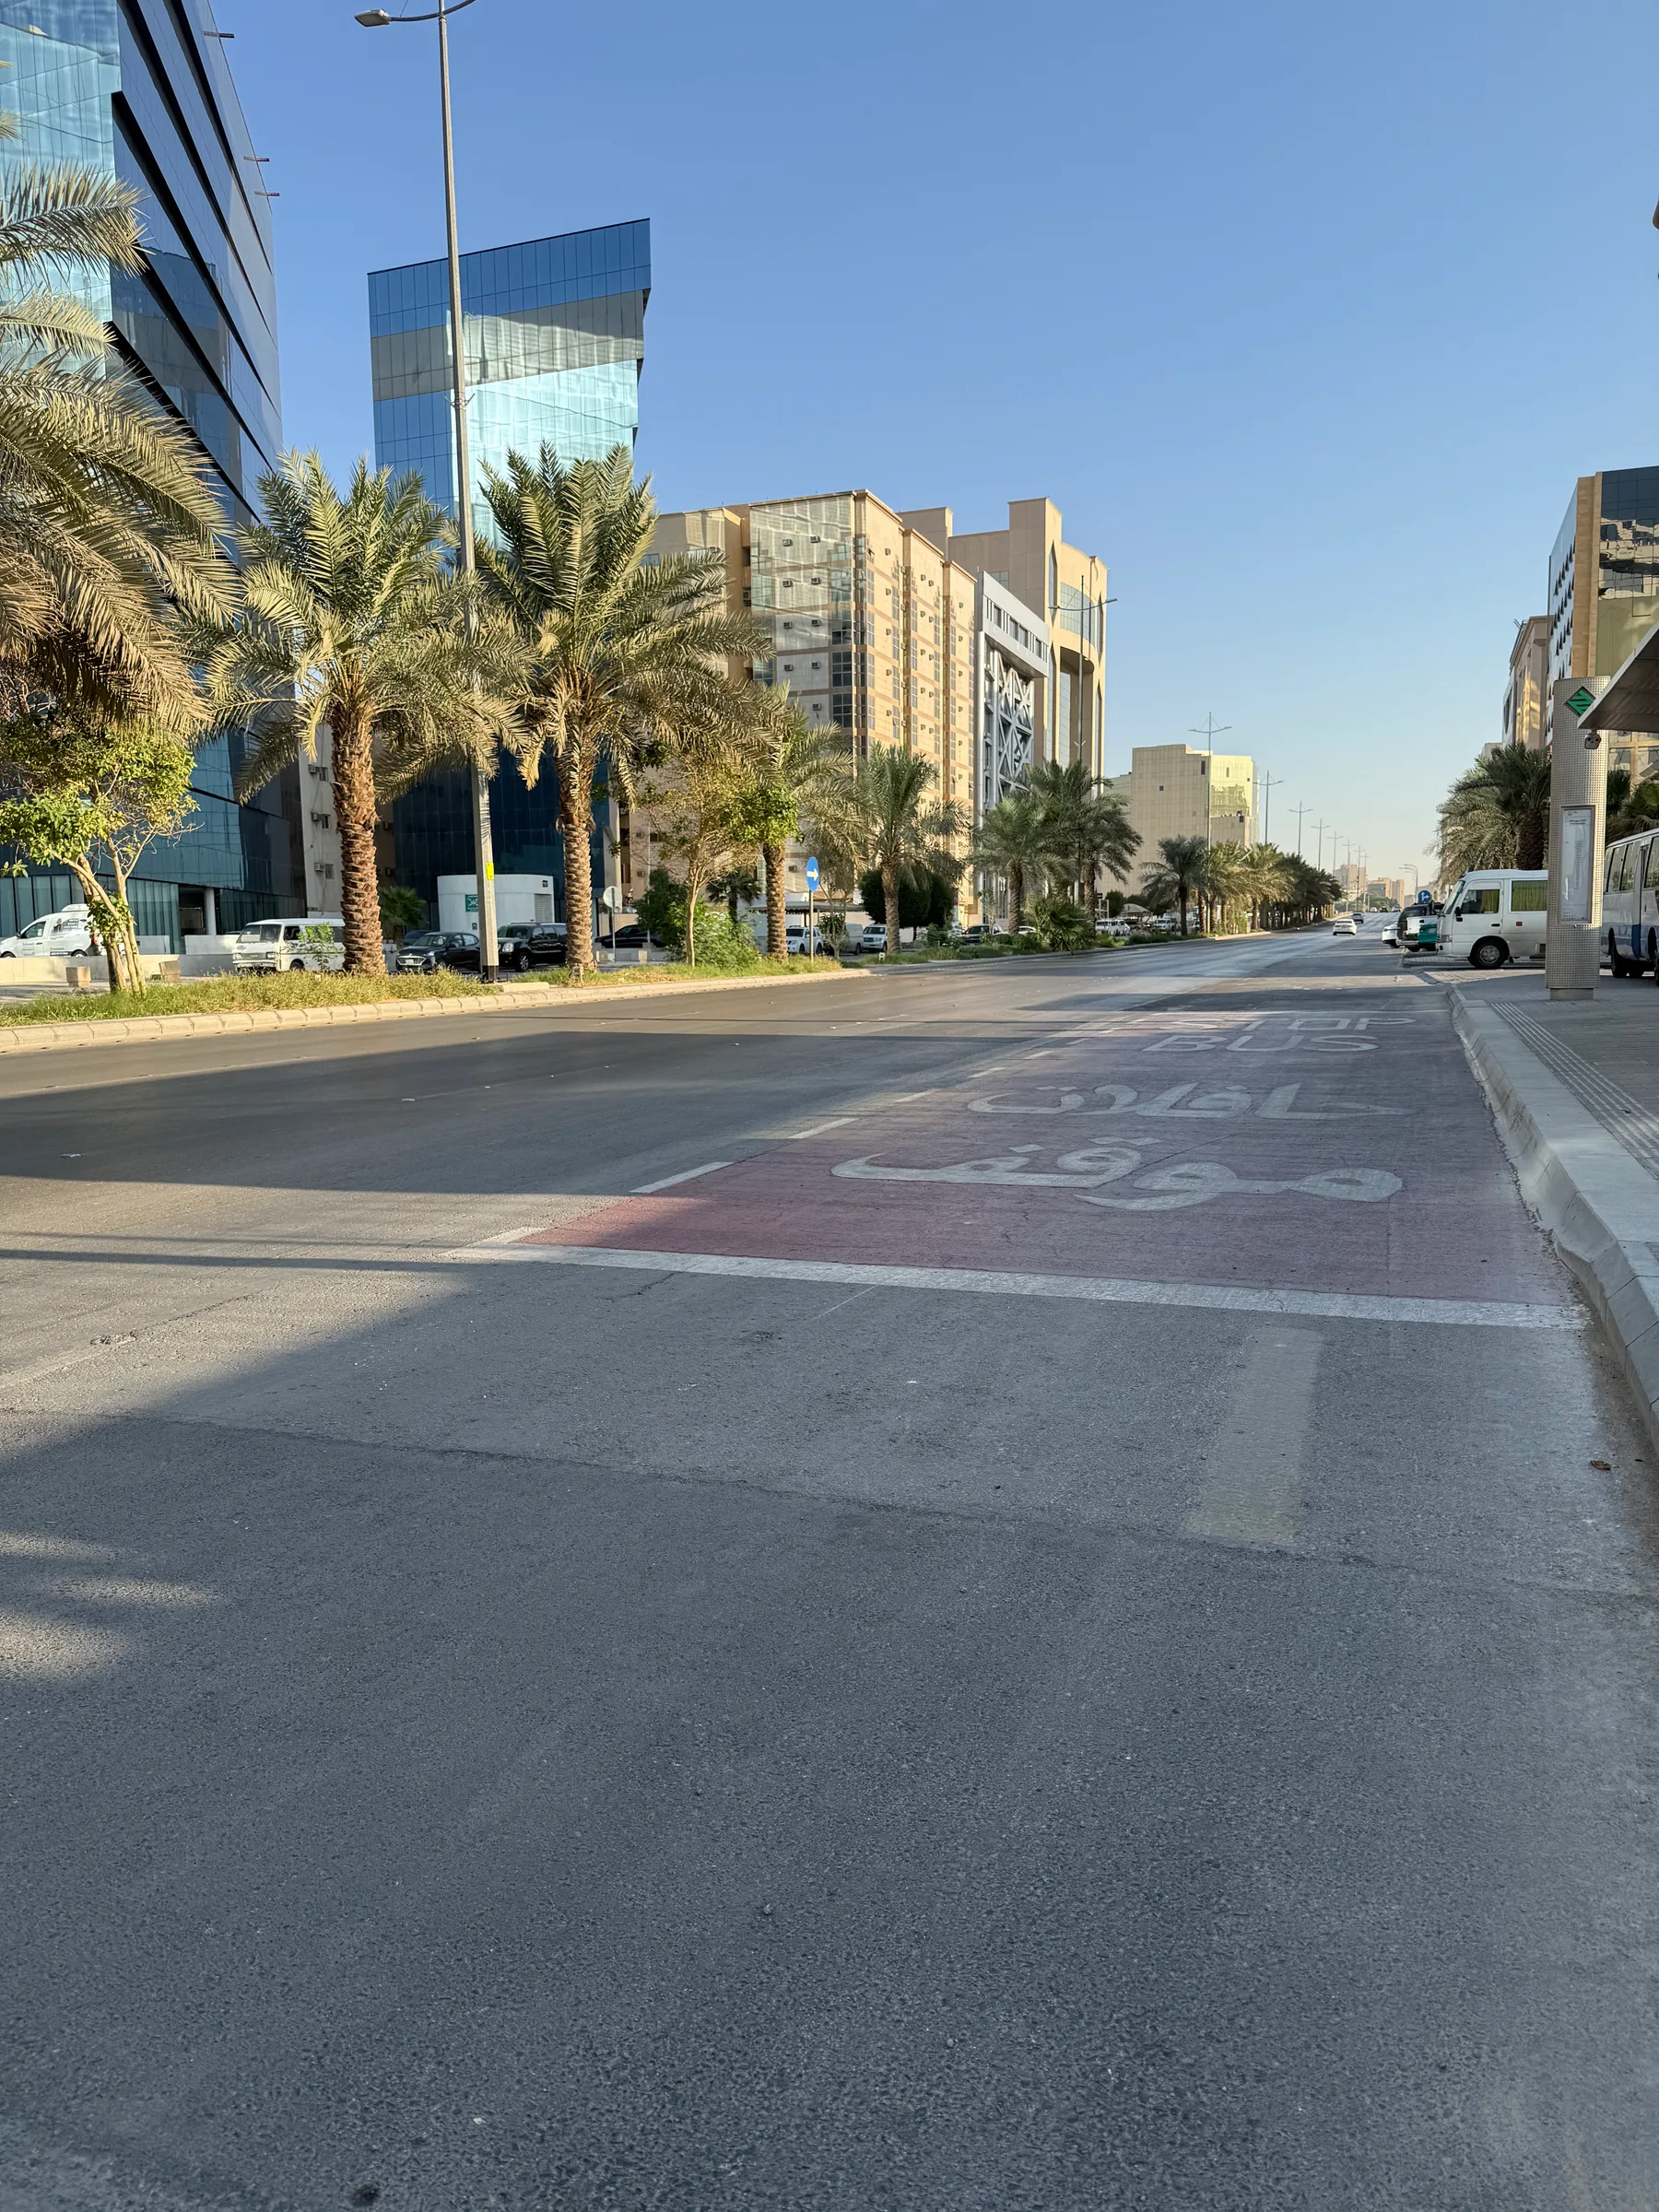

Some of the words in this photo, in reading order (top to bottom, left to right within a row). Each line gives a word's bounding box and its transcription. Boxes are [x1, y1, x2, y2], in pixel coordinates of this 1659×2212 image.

[1159, 1018, 1417, 1031] STOP
[1142, 1035, 1380, 1053] BUS
[967, 1082, 1425, 1120] حافلات
[830, 1135, 1404, 1211] موقف
